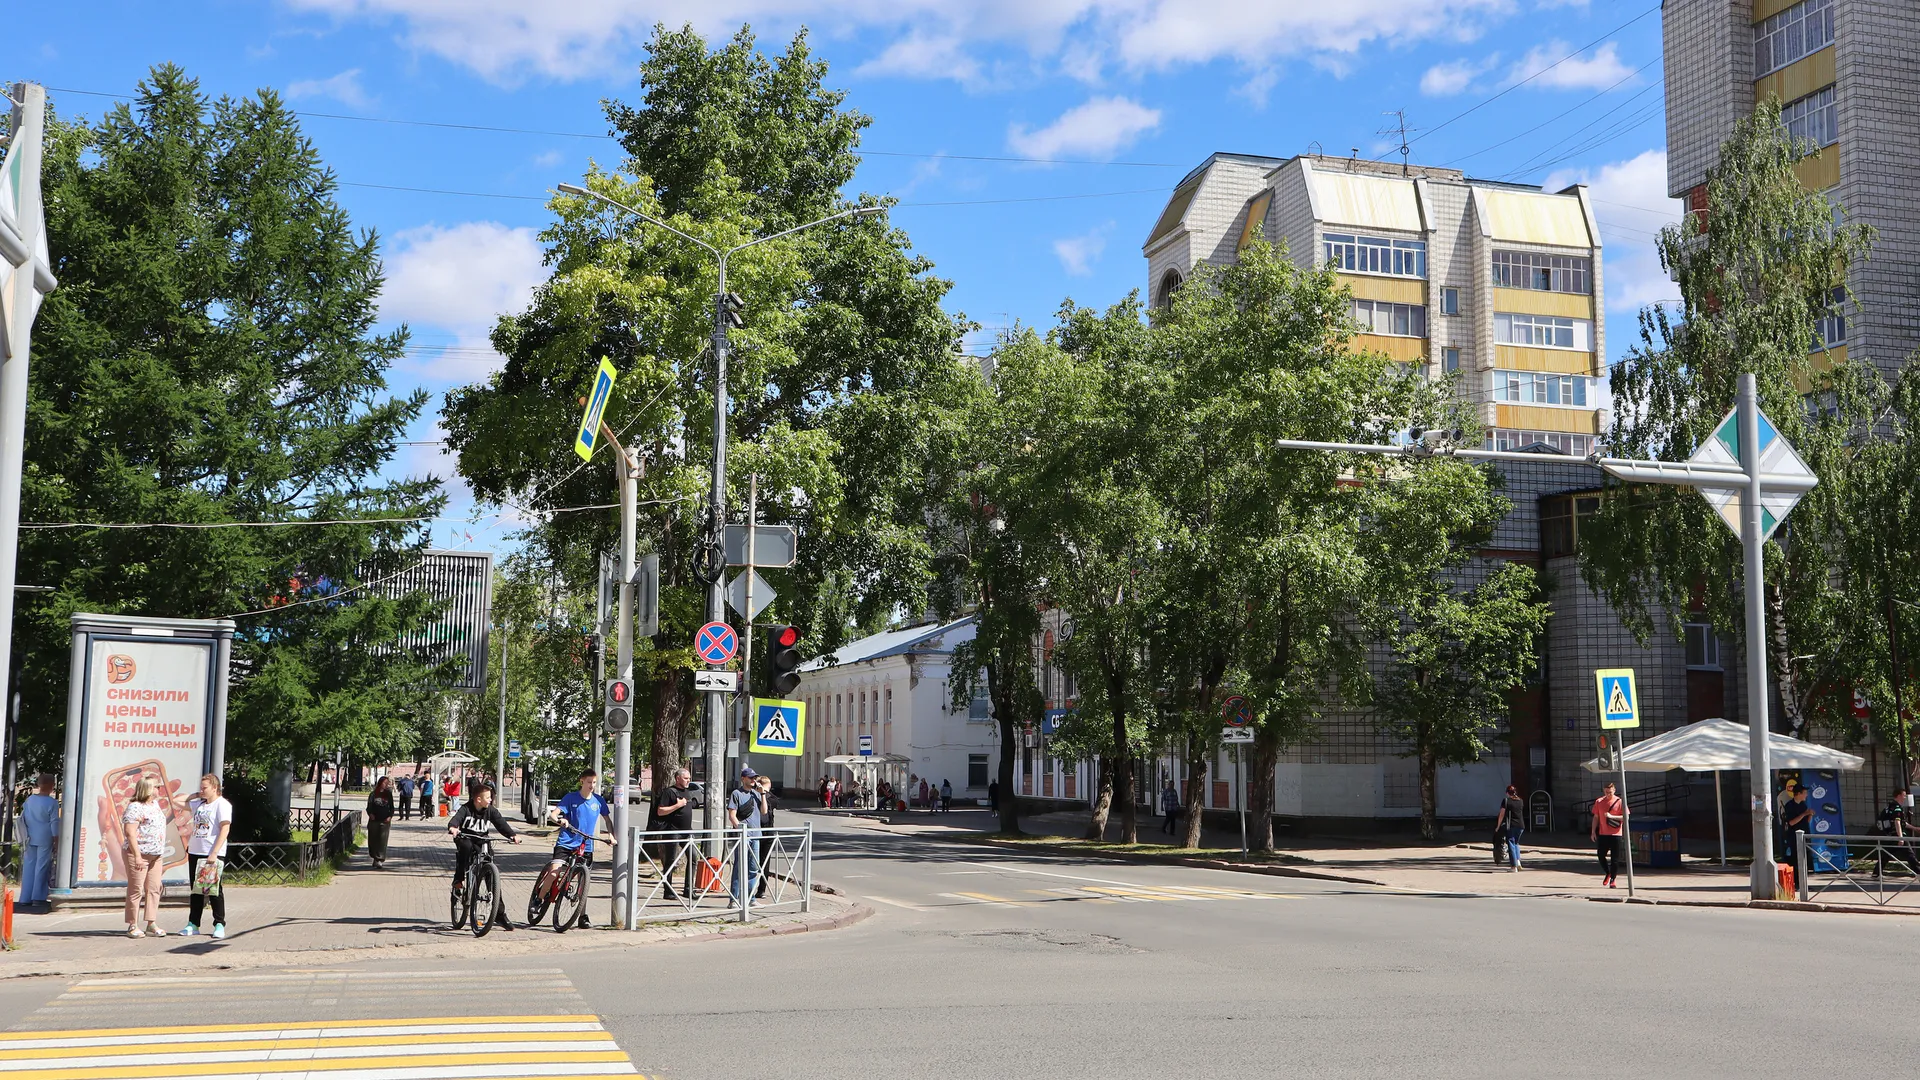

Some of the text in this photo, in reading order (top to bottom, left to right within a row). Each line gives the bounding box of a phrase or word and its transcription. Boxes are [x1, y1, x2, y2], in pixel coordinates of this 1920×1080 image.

[107, 688, 189, 702] снизили
[105, 705, 157, 718] цены
[104, 721, 196, 737] на пиццы
[103, 739, 197, 749] в приложении
[78, 827, 87, 855] пицца
